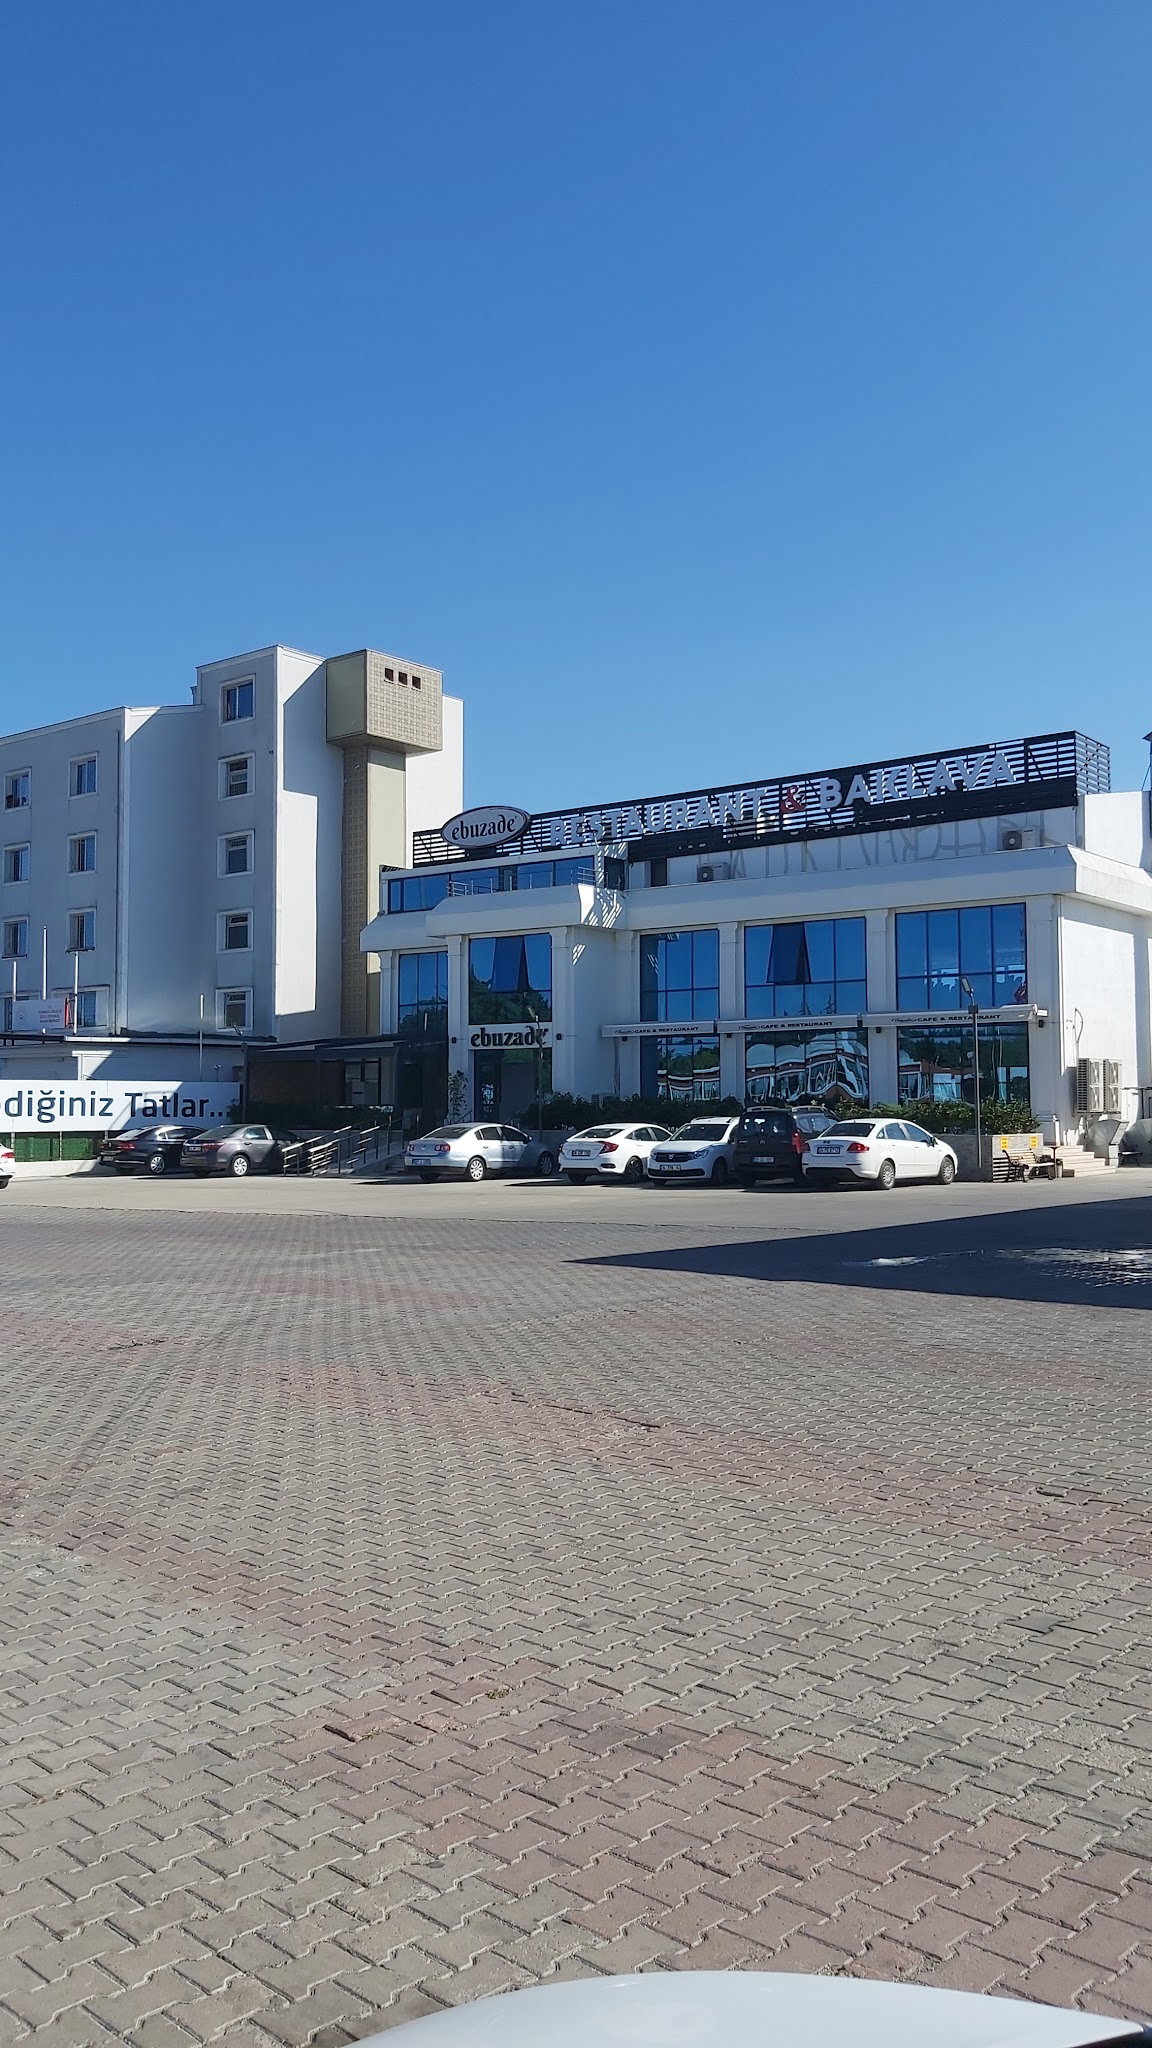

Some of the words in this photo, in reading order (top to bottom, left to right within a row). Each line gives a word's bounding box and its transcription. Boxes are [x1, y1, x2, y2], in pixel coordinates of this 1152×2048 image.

[550, 786, 767, 846] RESTAURANT
[780, 784, 806, 815] &
[818, 751, 1017, 810] BAKLAVA
[451, 813, 517, 842] ebuzade
[470, 1025, 549, 1047] ebuzade
[0, 1089, 113, 1124] diğiniz
